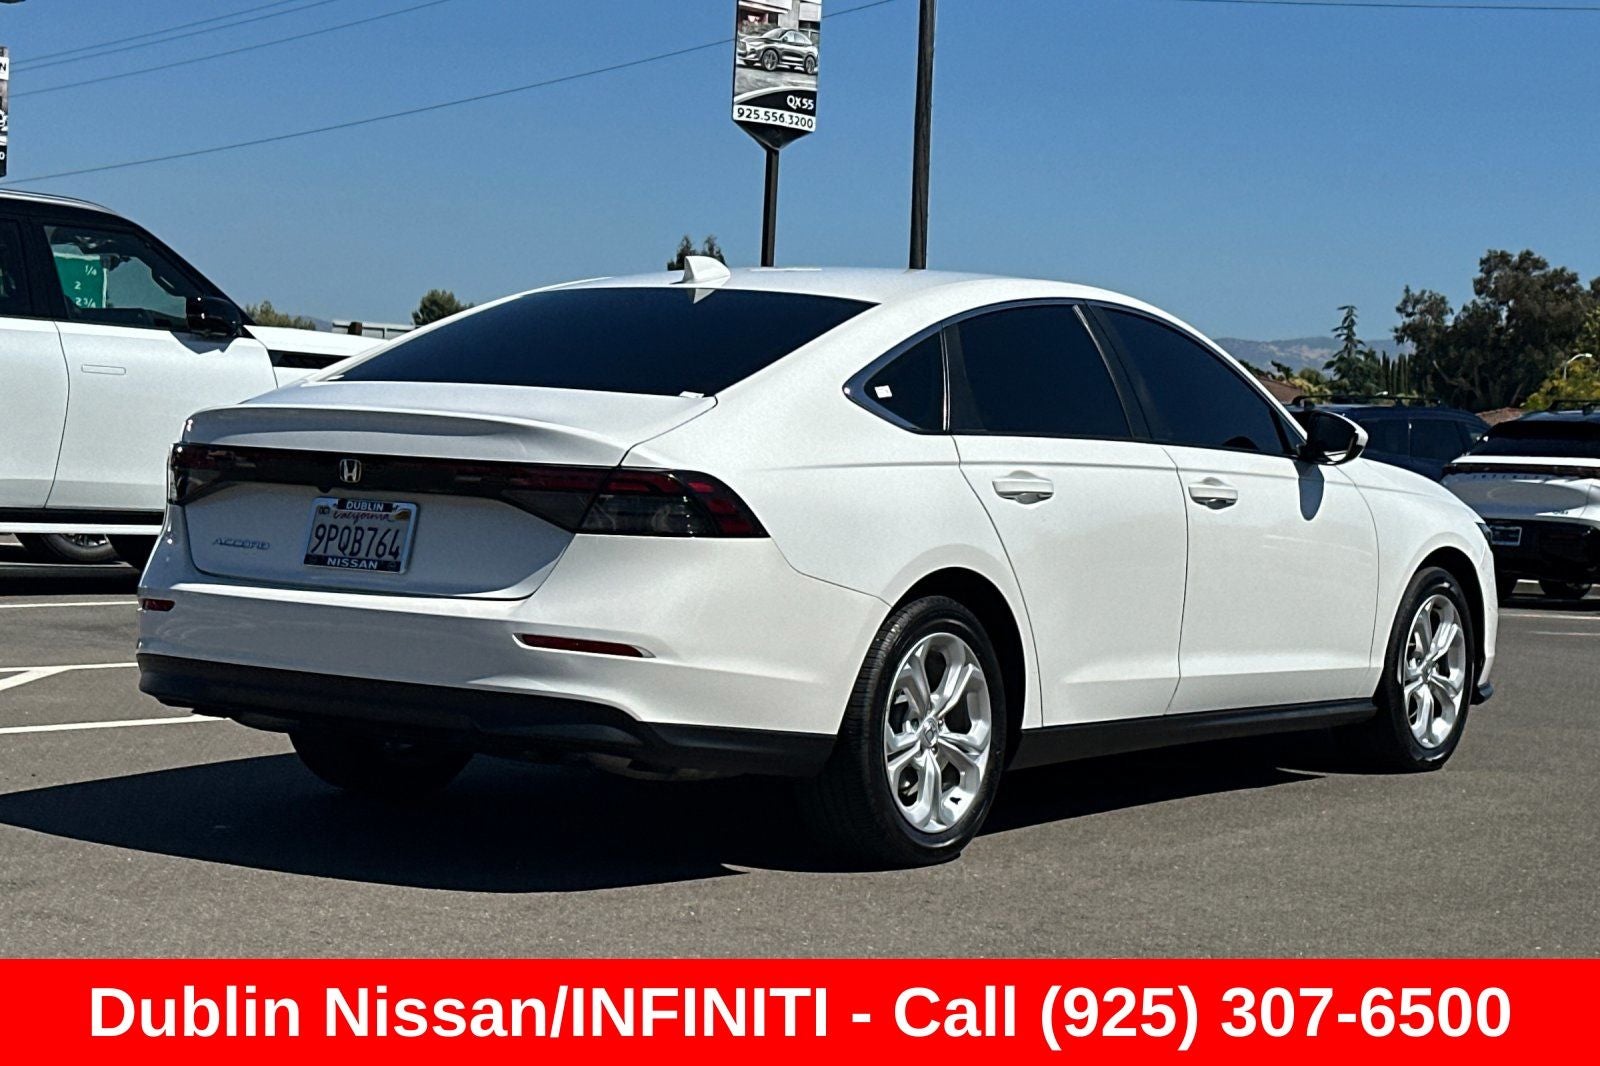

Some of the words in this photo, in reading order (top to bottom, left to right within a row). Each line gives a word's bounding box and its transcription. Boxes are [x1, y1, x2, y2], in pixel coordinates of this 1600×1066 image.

[786, 95, 814, 110] QX55
[737, 107, 814, 129] 925.556.3200
[74, 281, 81, 290] 2
[345, 501, 384, 511] DUBLIN
[311, 524, 400, 559] 9PQB764
[326, 557, 378, 569] NISSAN
